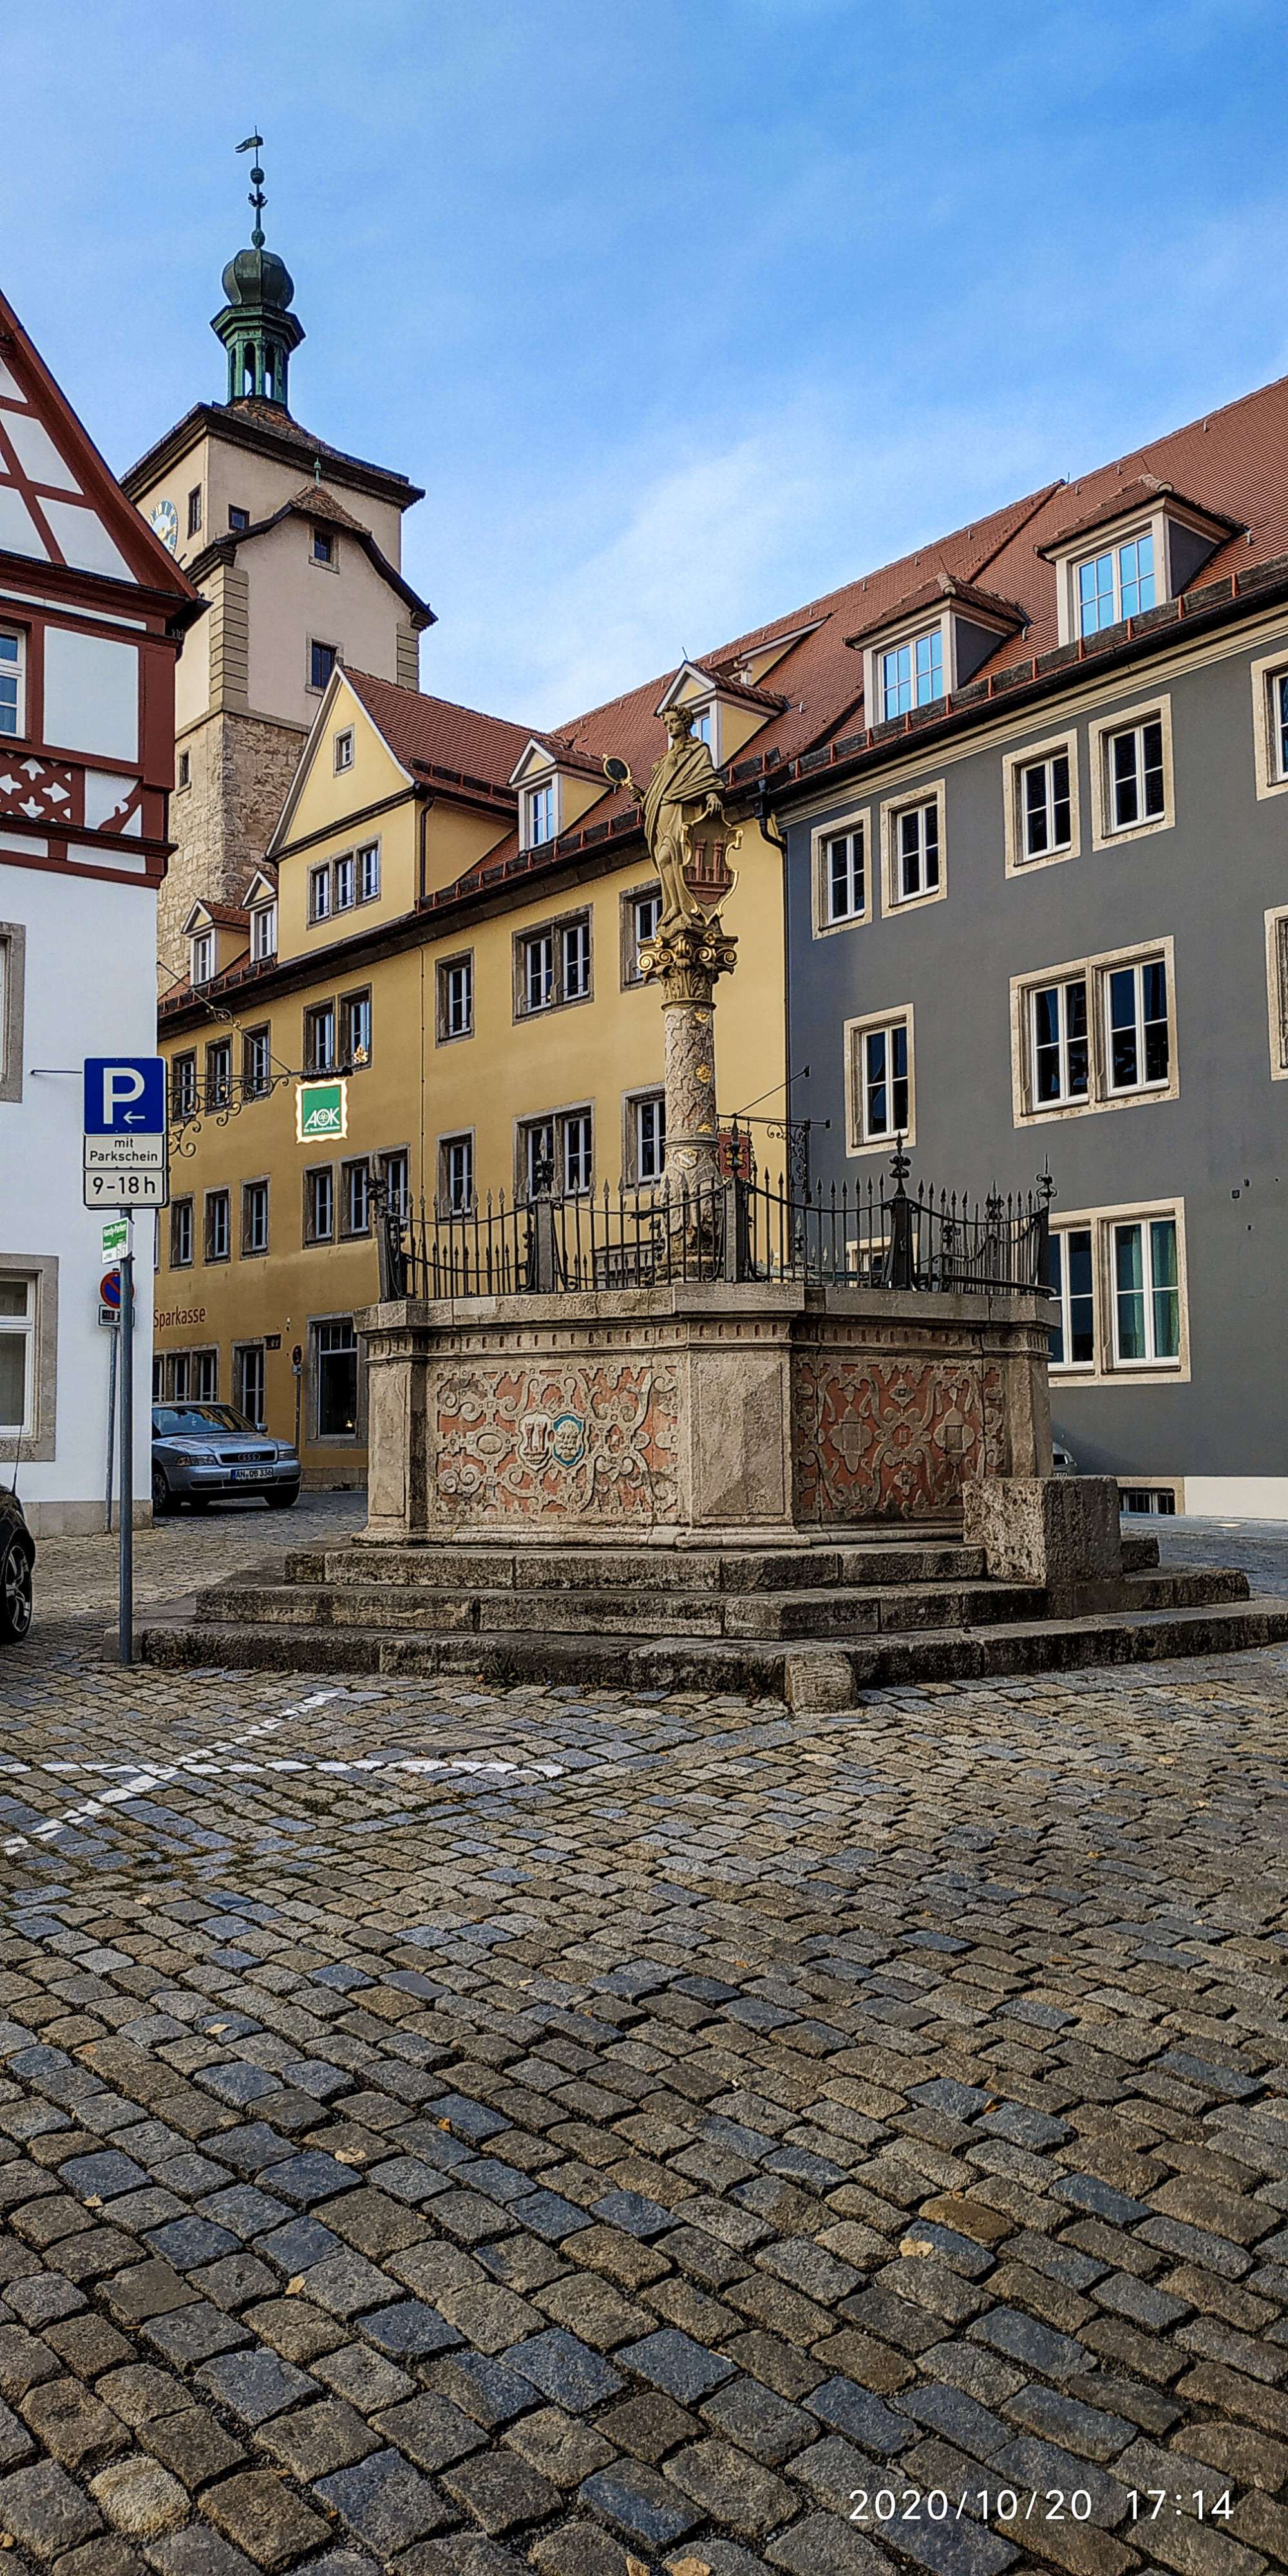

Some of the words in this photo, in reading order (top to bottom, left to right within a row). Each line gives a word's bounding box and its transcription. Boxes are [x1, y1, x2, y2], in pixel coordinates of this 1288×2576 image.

[103, 1067, 145, 1124] P
[304, 1107, 340, 1128] AOK
[115, 1138, 133, 1148] mit
[90, 1151, 158, 1161] Parkschein
[153, 1305, 205, 1332] Sparkasse
